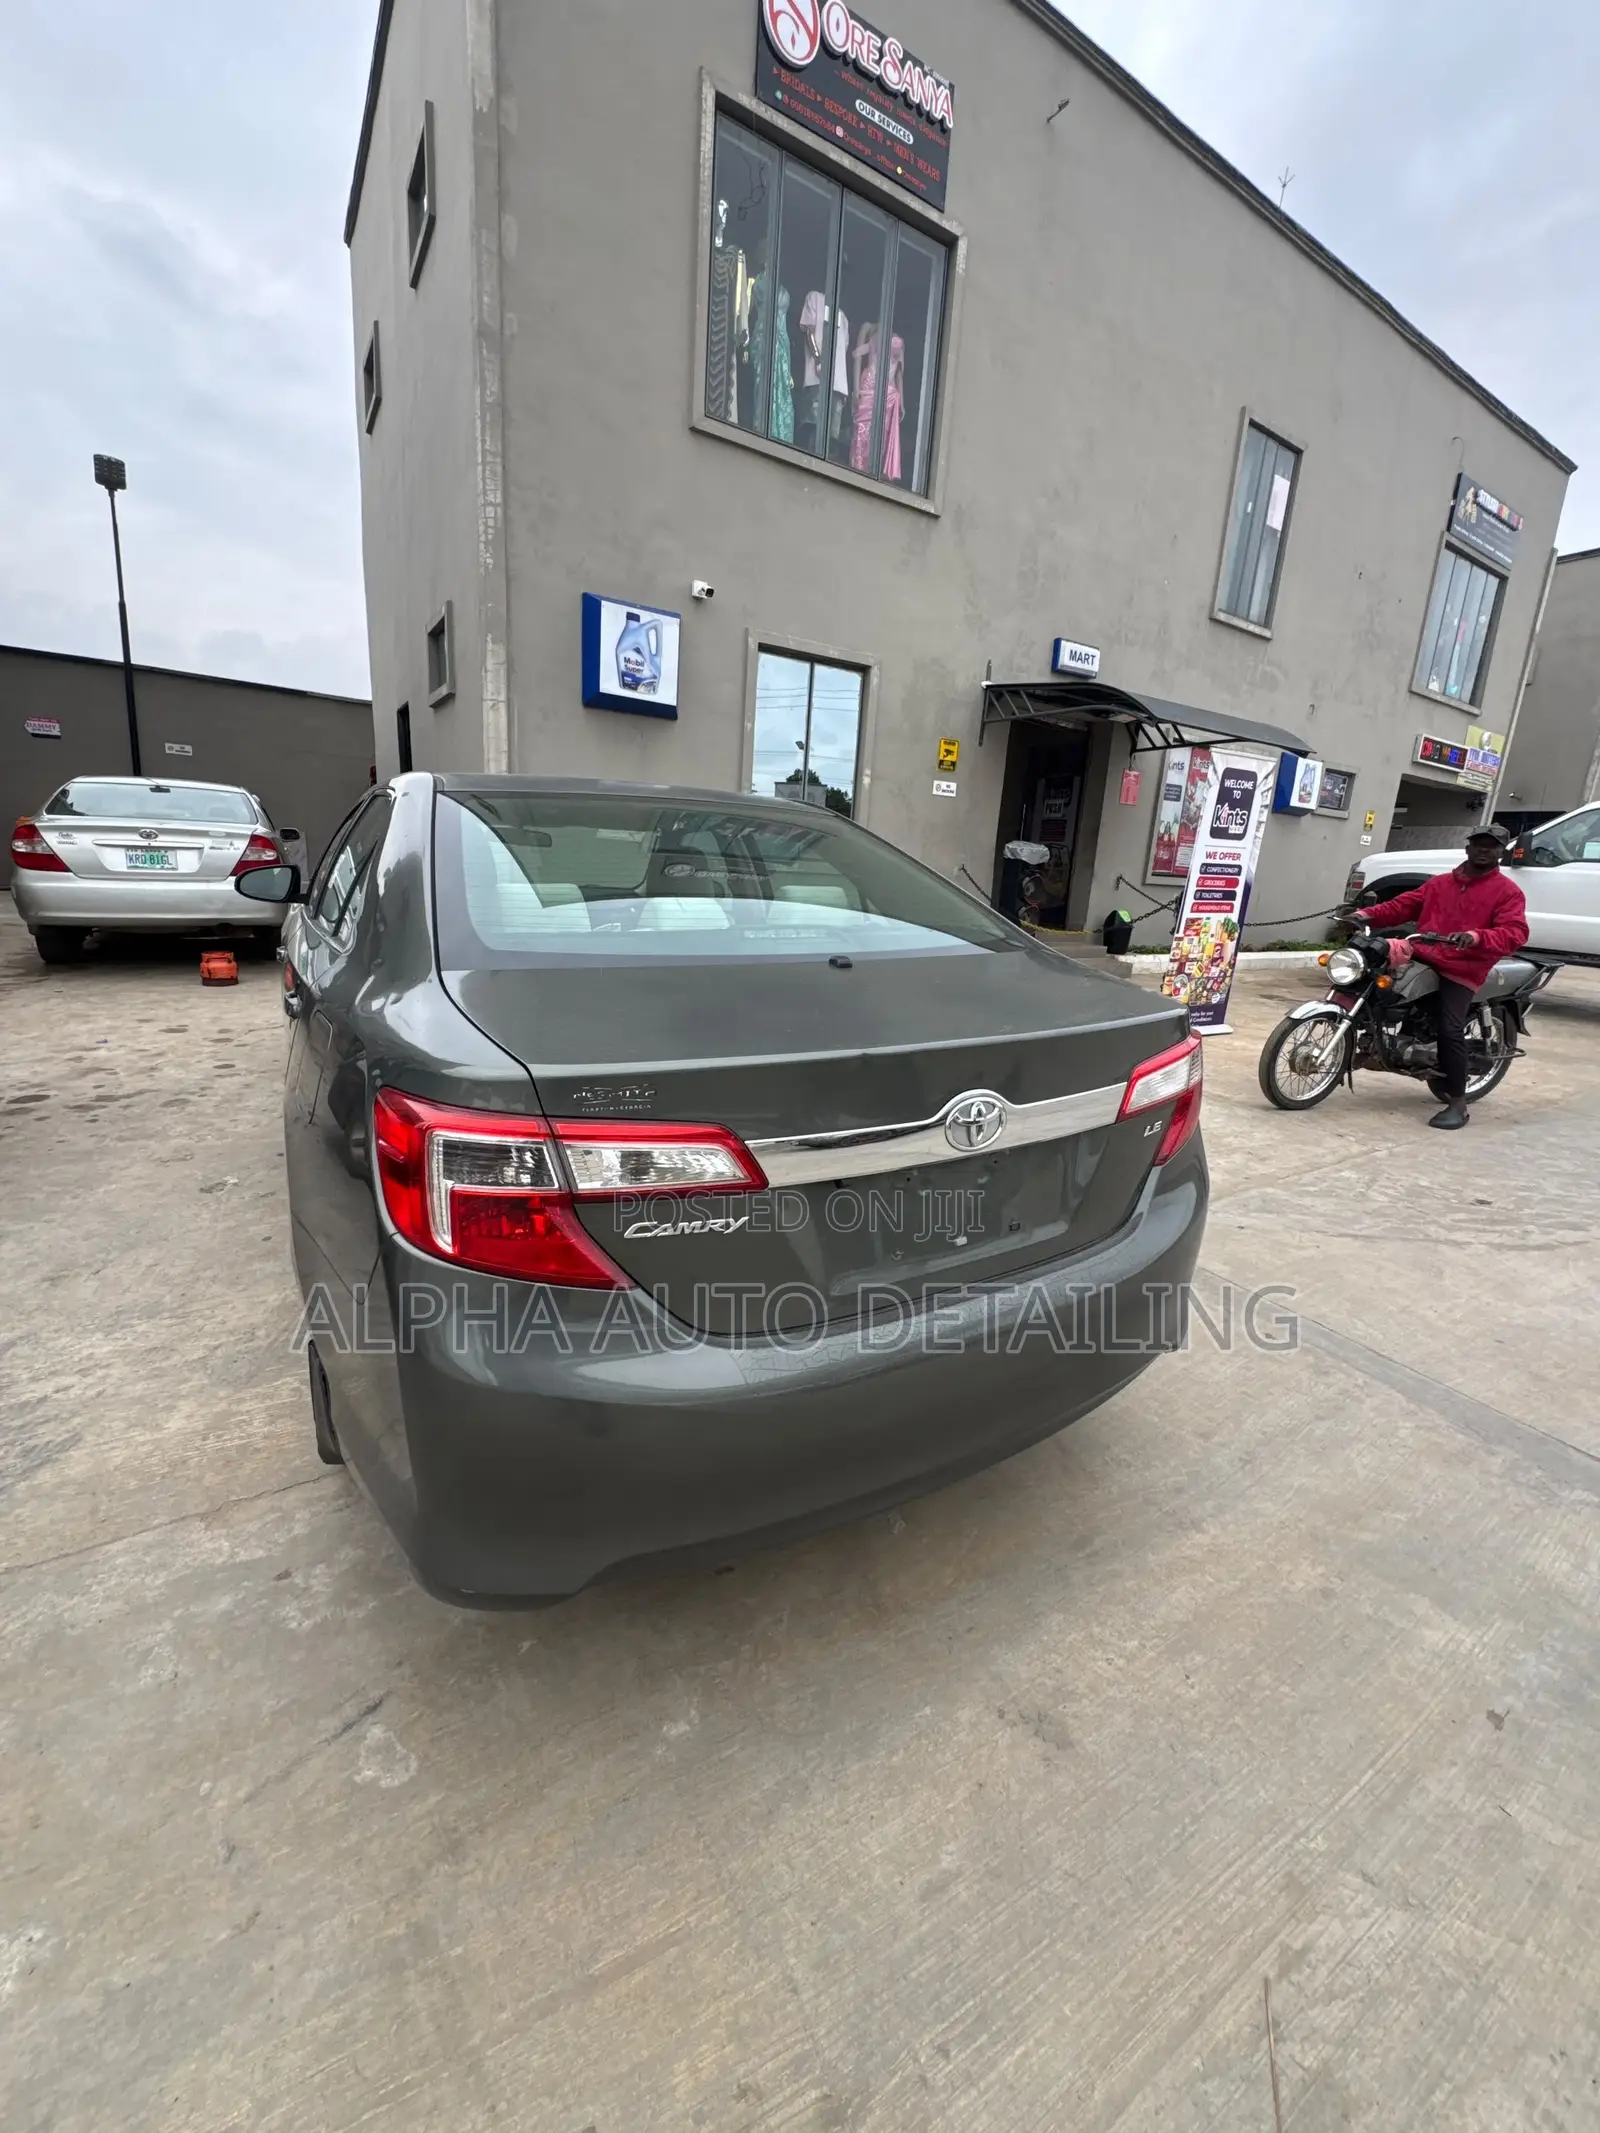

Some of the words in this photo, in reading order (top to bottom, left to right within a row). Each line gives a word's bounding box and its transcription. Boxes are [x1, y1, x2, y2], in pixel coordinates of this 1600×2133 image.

[858, 102, 876, 118] OUR
[878, 114, 912, 143] SERVICES
[624, 656, 645, 667] Mobil
[1069, 649, 1097, 667] MART
[624, 664, 644, 673] Super
[1224, 778, 1255, 790] WELCOME
[1233, 790, 1242, 799] TO
[1213, 802, 1248, 827] Kints
[1205, 851, 1218, 860] WE
[1219, 851, 1242, 861] OFFER
[1143, 1120, 1163, 1138] LE
[623, 1216, 750, 1240] CAMRY
